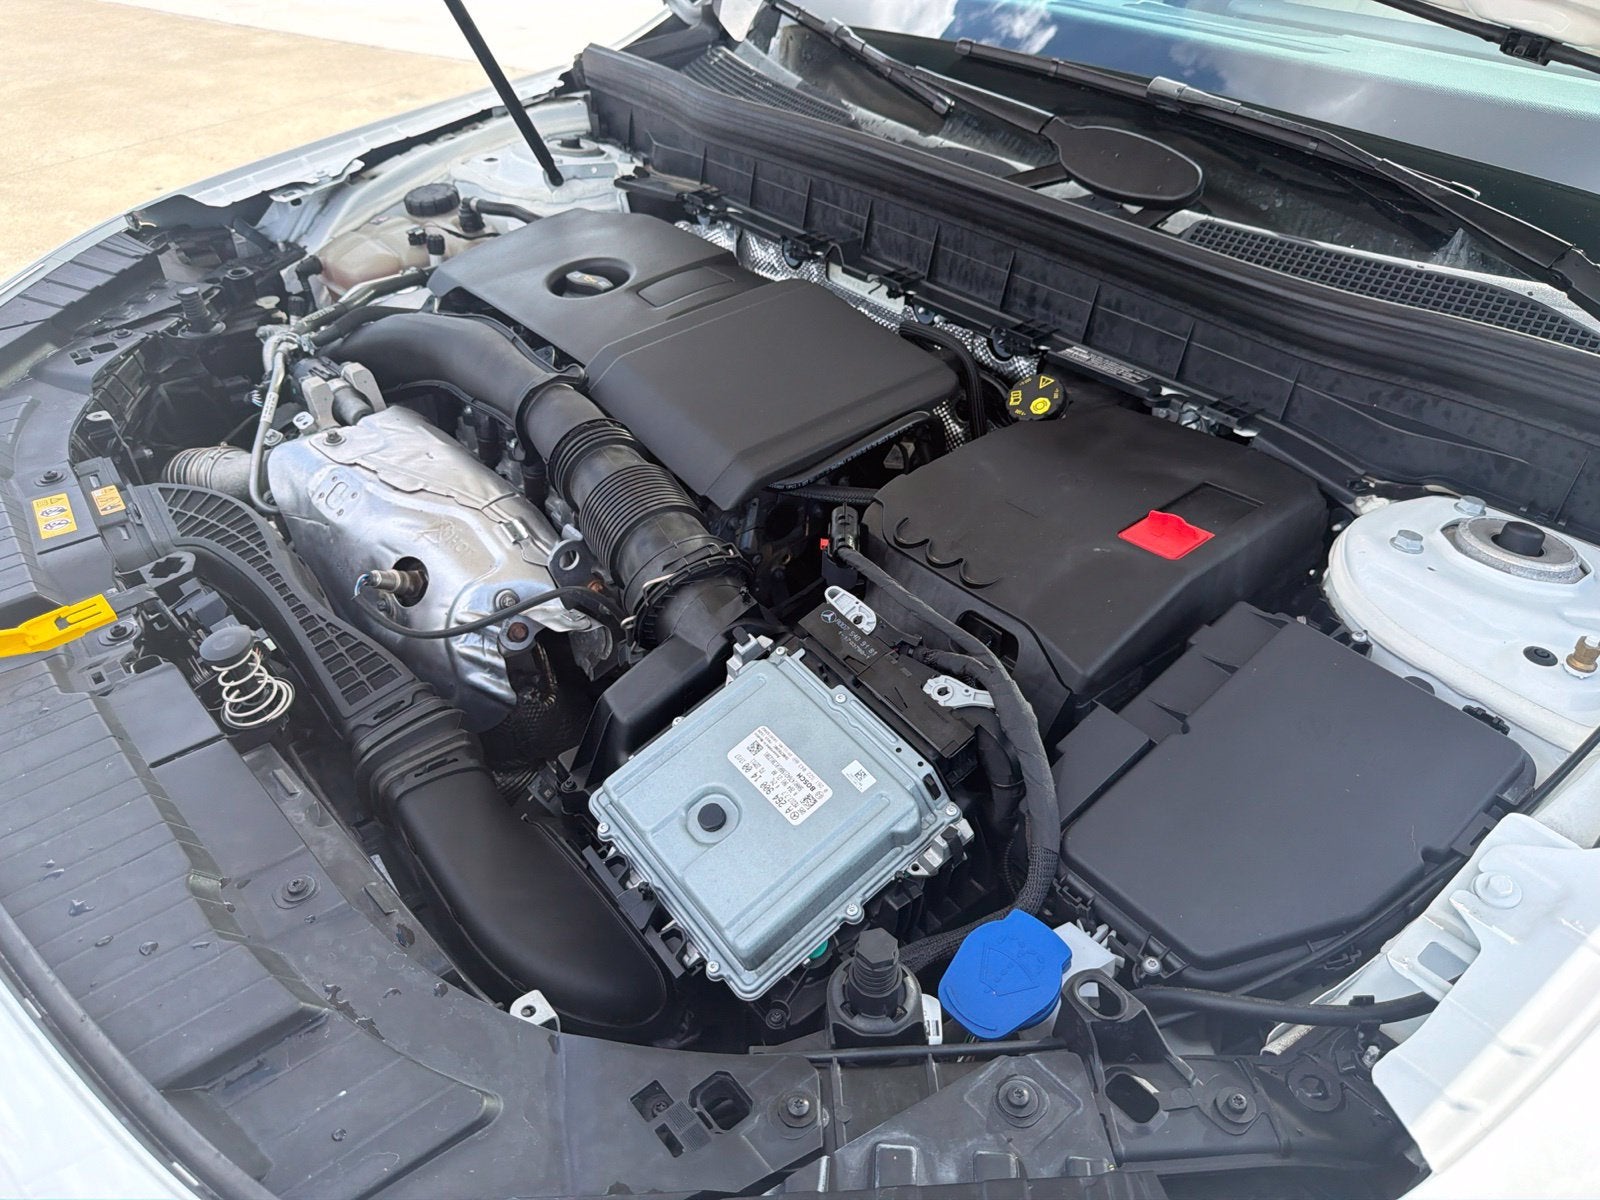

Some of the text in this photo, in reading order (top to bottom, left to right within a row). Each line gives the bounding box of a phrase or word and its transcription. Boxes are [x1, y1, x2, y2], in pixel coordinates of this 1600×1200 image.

[849, 630, 862, 642] 540
[740, 762, 753, 773] 00
[750, 771, 762, 782] 14
[796, 772, 816, 791] BOSCH
[758, 780, 774, 795] 900
[771, 793, 786, 807] 264
[784, 805, 793, 814] A
